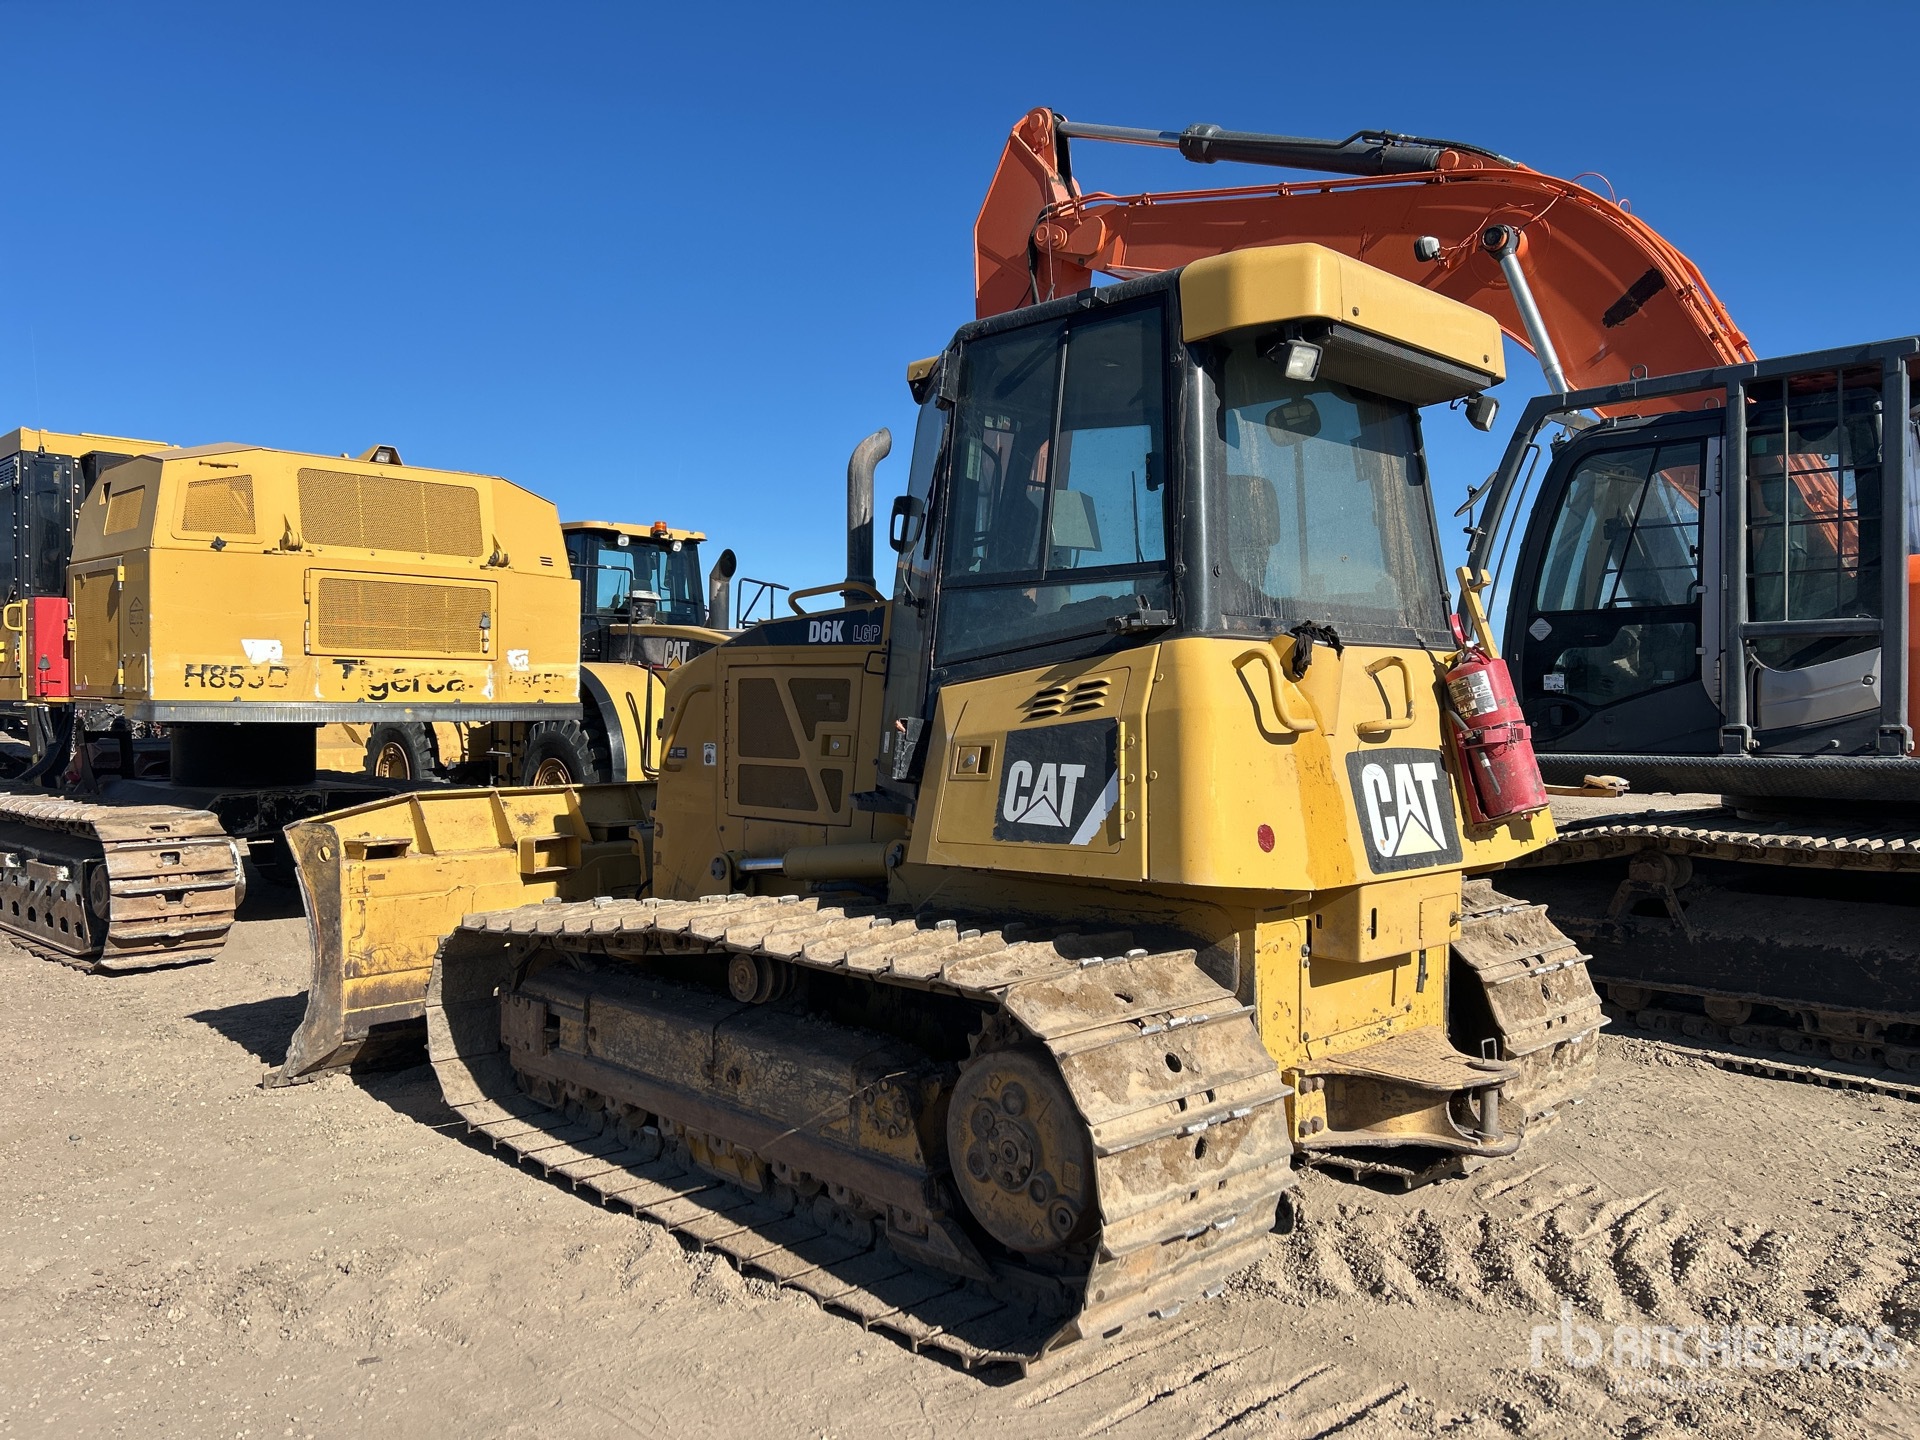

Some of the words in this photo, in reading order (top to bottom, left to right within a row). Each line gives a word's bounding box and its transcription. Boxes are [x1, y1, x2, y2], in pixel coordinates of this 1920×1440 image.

[664, 640, 690, 668] CAT
[808, 620, 844, 643] D6K
[852, 624, 881, 643] LGP
[1003, 760, 1086, 828] CAT
[1361, 763, 1448, 858] CAT
